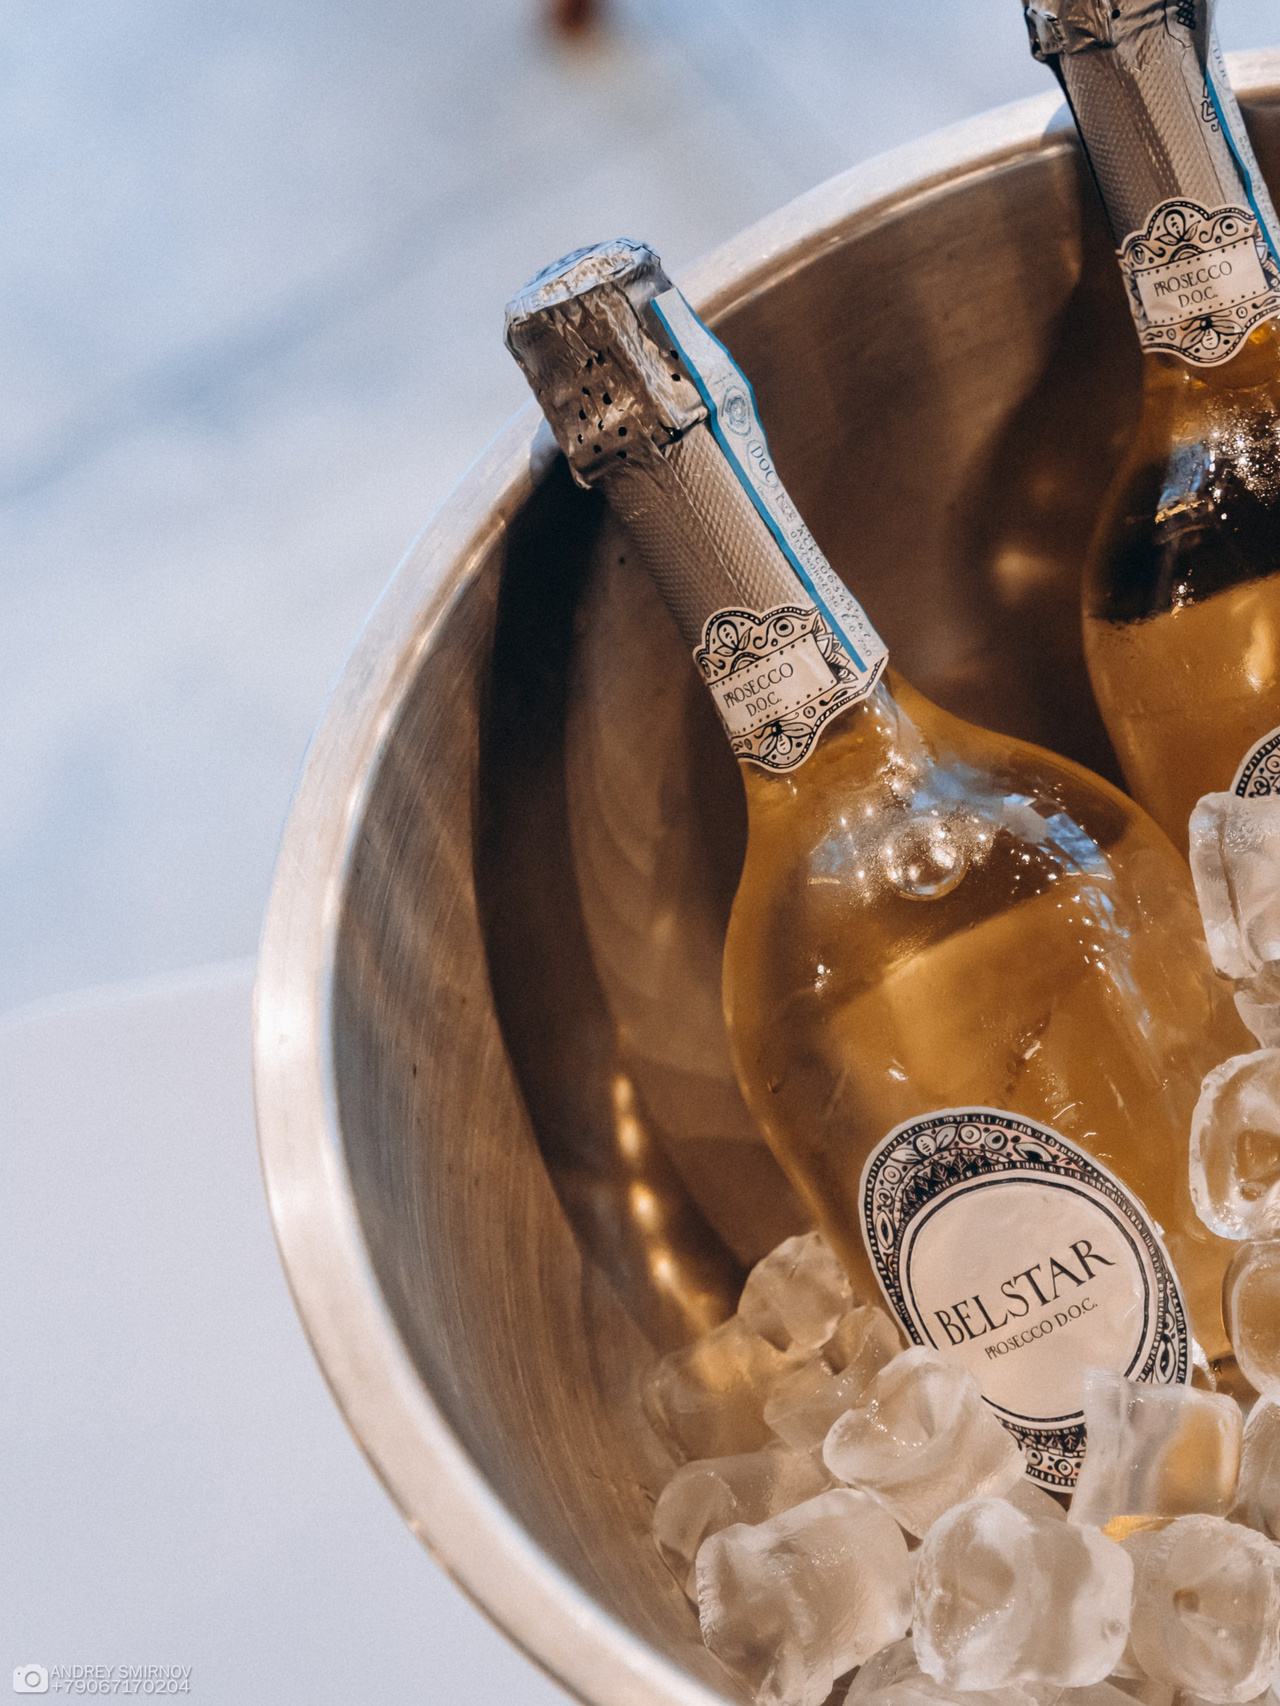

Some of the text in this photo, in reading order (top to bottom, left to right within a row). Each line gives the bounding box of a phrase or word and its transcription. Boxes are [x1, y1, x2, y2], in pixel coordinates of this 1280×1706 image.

[1153, 260, 1233, 297] PROSECCO
[1177, 286, 1219, 308] D.O.C.
[750, 445, 775, 483] DOC
[722, 662, 795, 709] PROSECCO
[744, 691, 783, 718] D.O.C.
[933, 1238, 1116, 1346] BELSTAR
[984, 1297, 1098, 1361] PROSECCO D.O.C.
